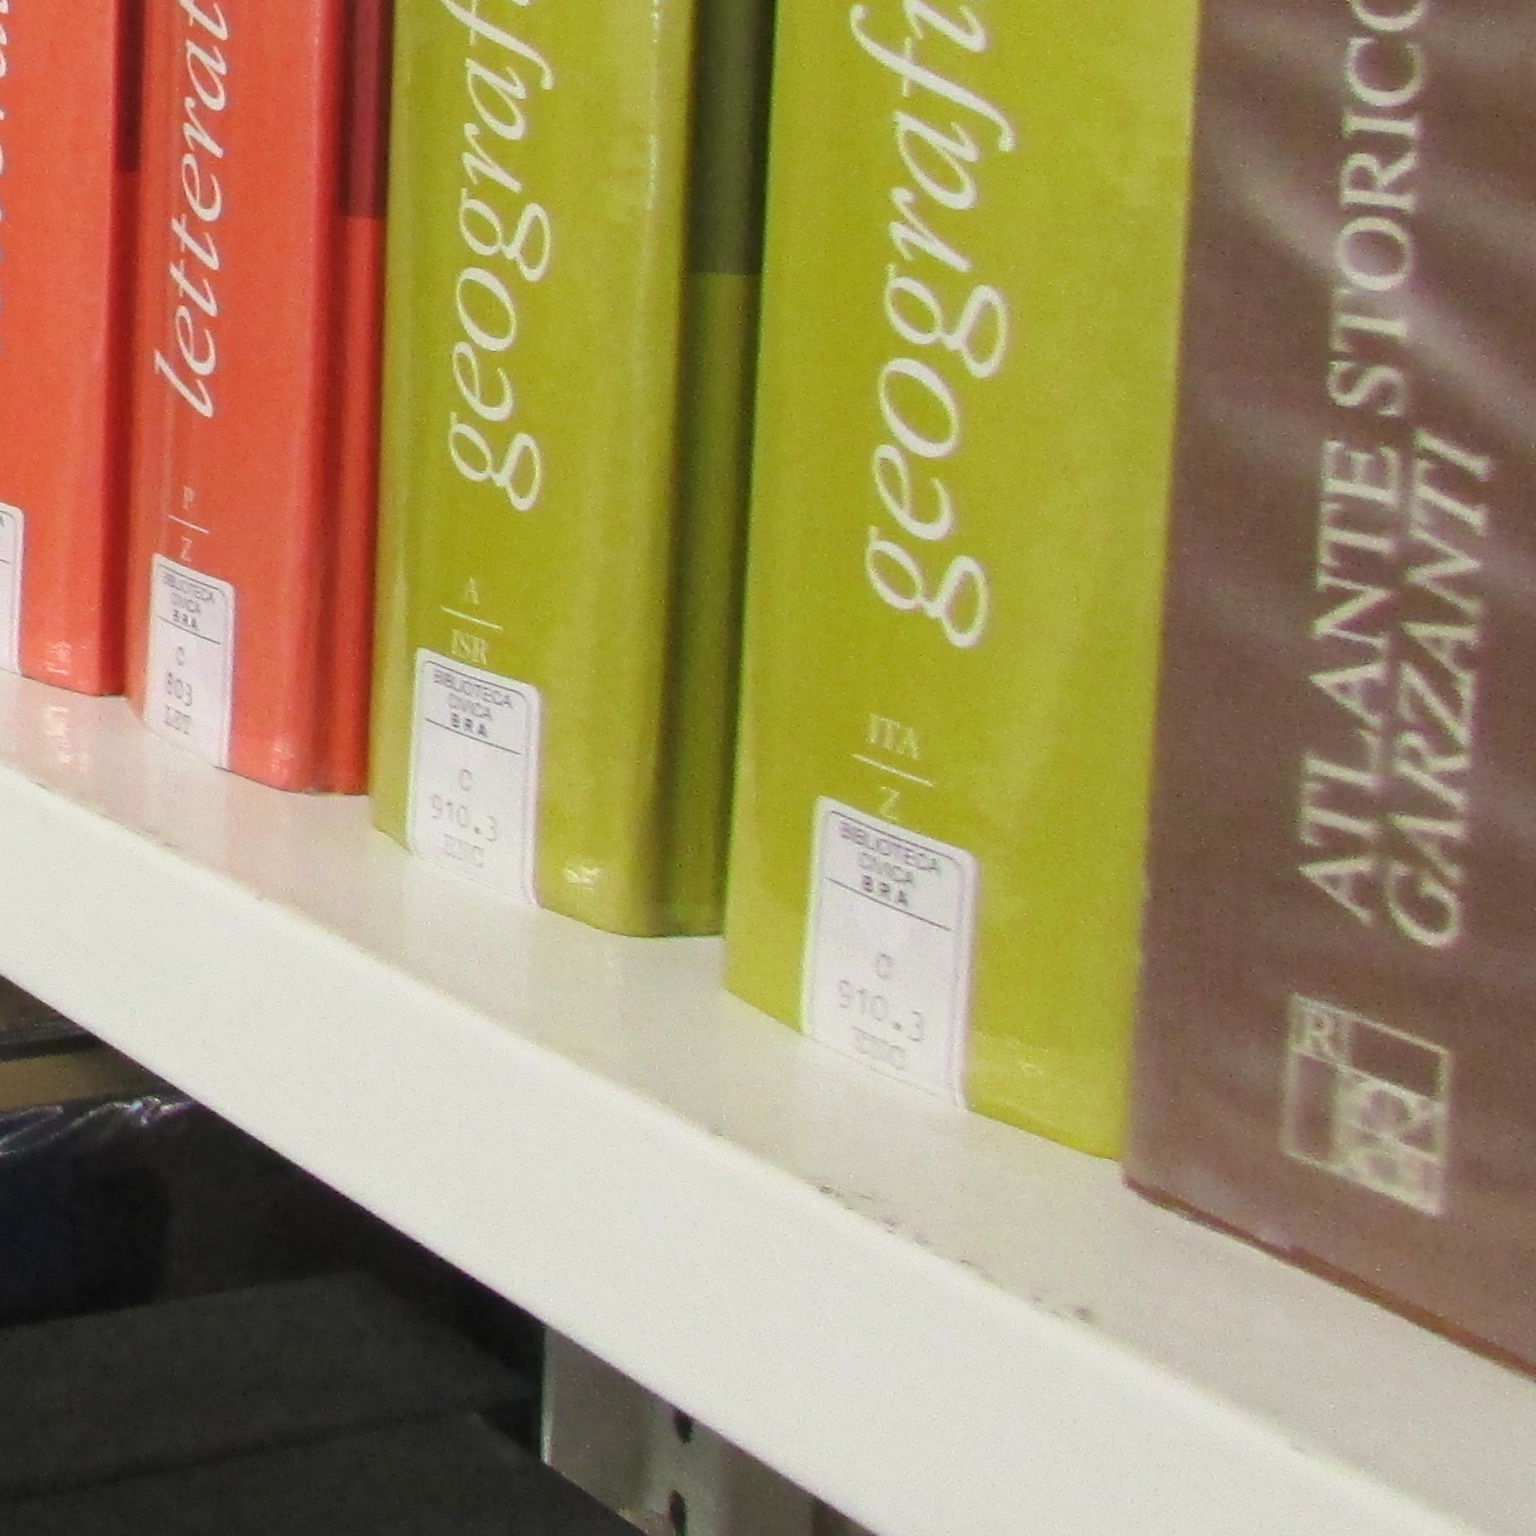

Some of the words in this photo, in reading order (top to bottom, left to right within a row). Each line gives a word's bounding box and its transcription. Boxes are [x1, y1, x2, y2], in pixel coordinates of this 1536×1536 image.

[464, 577, 480, 605] A
[172, 609, 199, 631] BRA
[433, 668, 514, 711] BIBLIOTECA
[1298, 438, 1400, 925] ATLANTE
[1384, 428, 1492, 949] GARZANTI
[447, 693, 493, 721] CIVICA
[450, 712, 488, 738] BRA
[867, 713, 921, 760] ITA
[458, 768, 473, 792] C
[879, 785, 901, 821] Z
[838, 820, 941, 874] BIBLIOTECA
[857, 851, 914, 885] CIVICA
[861, 873, 910, 907] BRA
[875, 952, 895, 981] C
